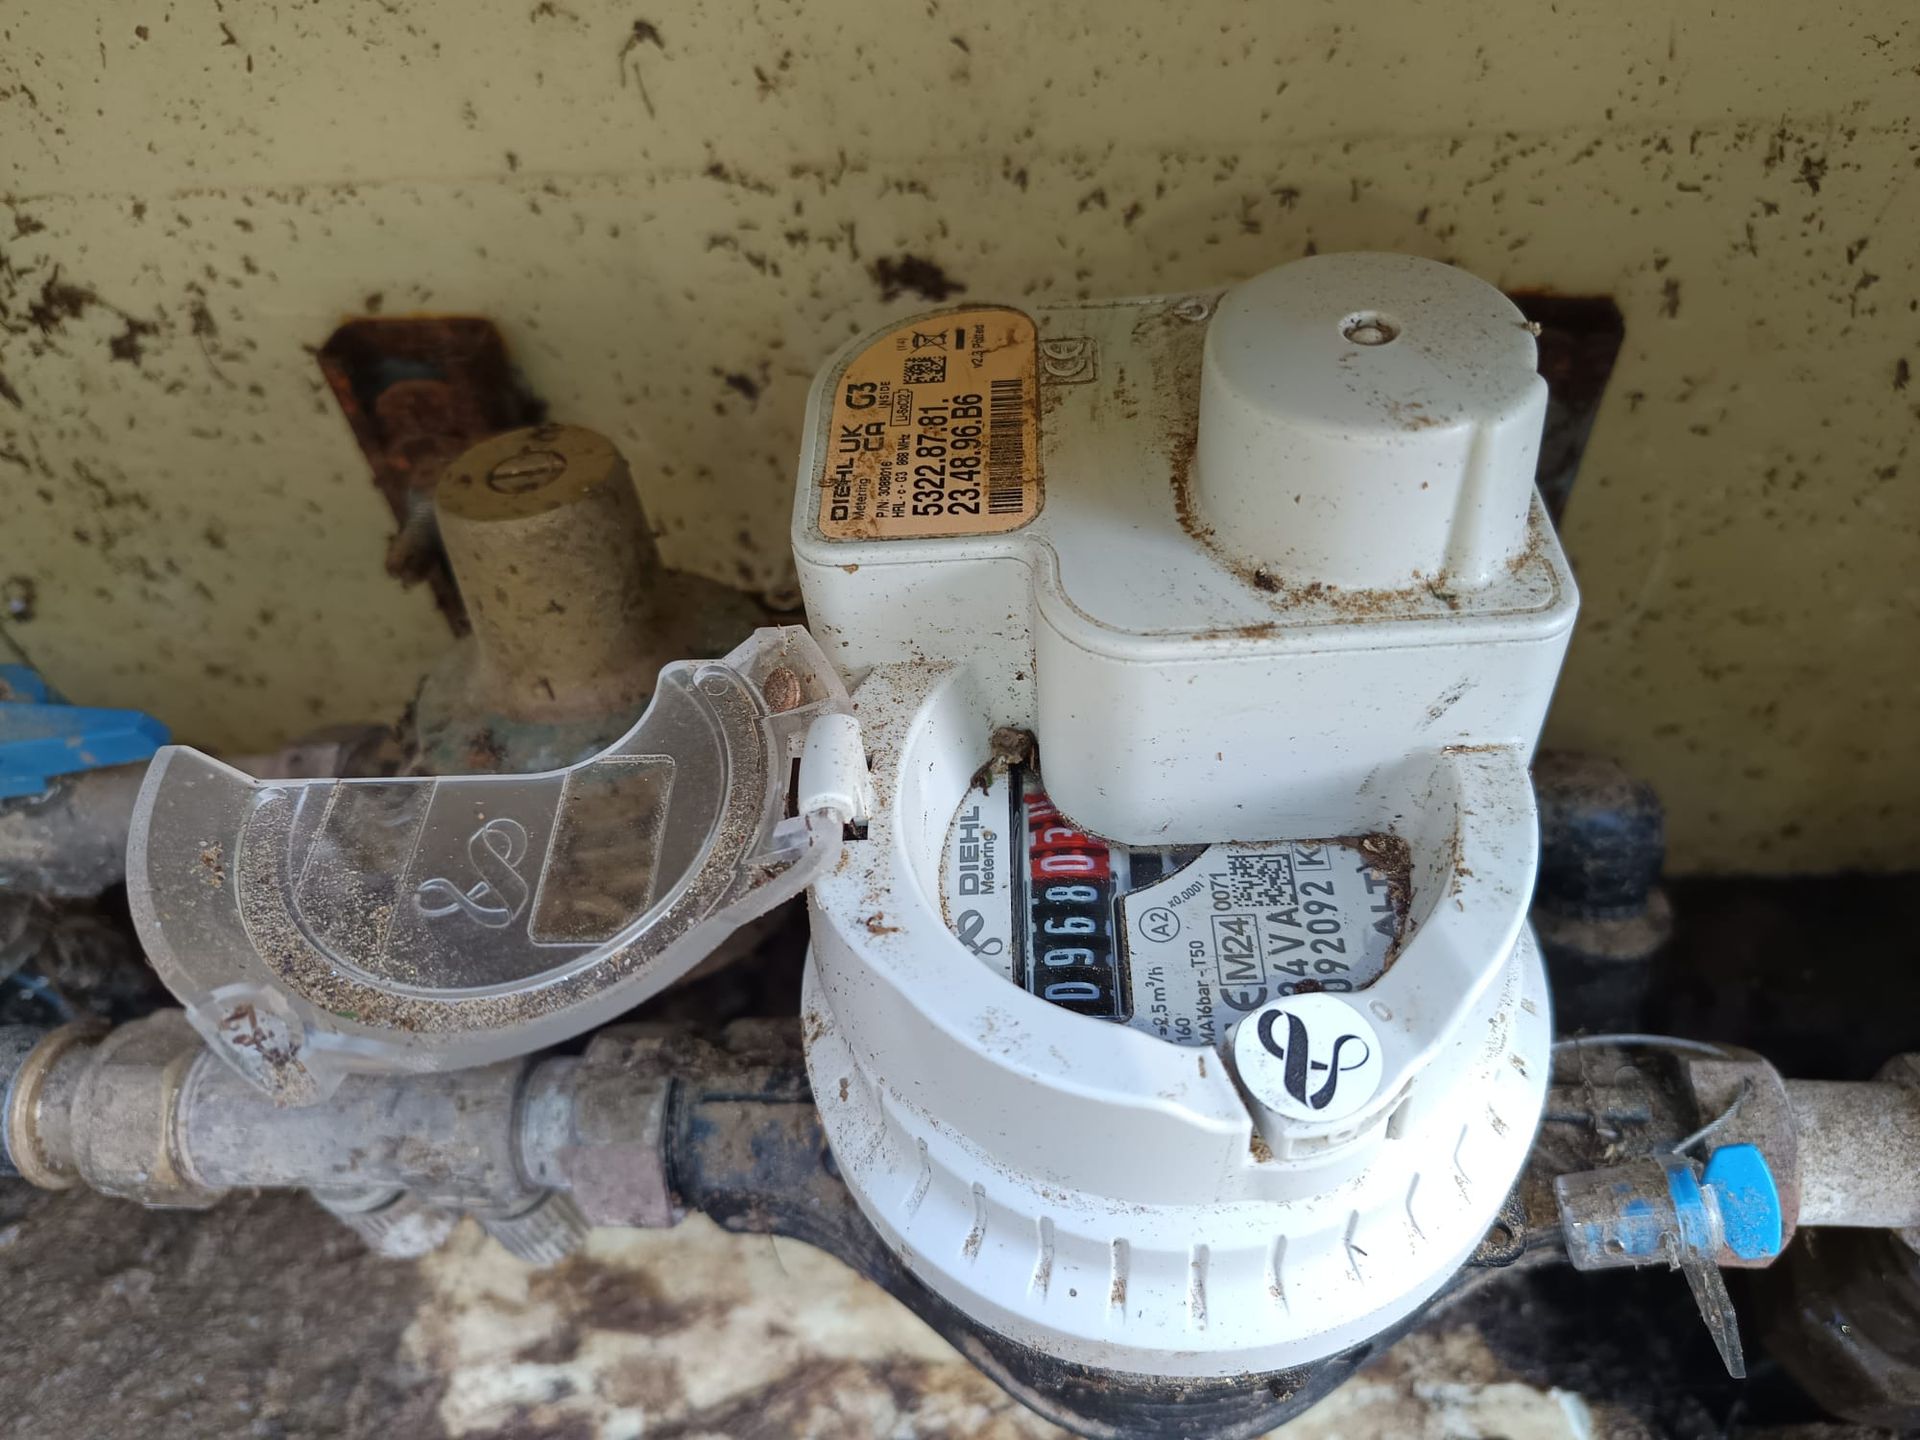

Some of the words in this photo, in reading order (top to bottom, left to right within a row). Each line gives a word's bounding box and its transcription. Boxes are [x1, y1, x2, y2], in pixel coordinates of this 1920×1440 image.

[846, 382, 877, 410] G3
[878, 382, 890, 408] INSIDE
[839, 424, 863, 452] UK
[864, 422, 886, 452] CA
[897, 434, 910, 450] MHz
[912, 398, 948, 516] 5322.87.81.
[948, 394, 982, 515] 23.48.96.B6
[830, 458, 854, 520] DIEHL
[878, 461, 892, 496] 3088016
[895, 472, 908, 482] G3
[854, 478, 870, 520] Metering
[876, 499, 889, 518] P/N:
[960, 806, 980, 896] DIEHL
[980, 832, 997, 894] Metering
[1209, 872, 1232, 911] 0071
[1150, 912, 1171, 936] A2
[1190, 940, 1206, 968] T50
[1219, 918, 1257, 980] M24
[1175, 1018, 1192, 1042] 160
